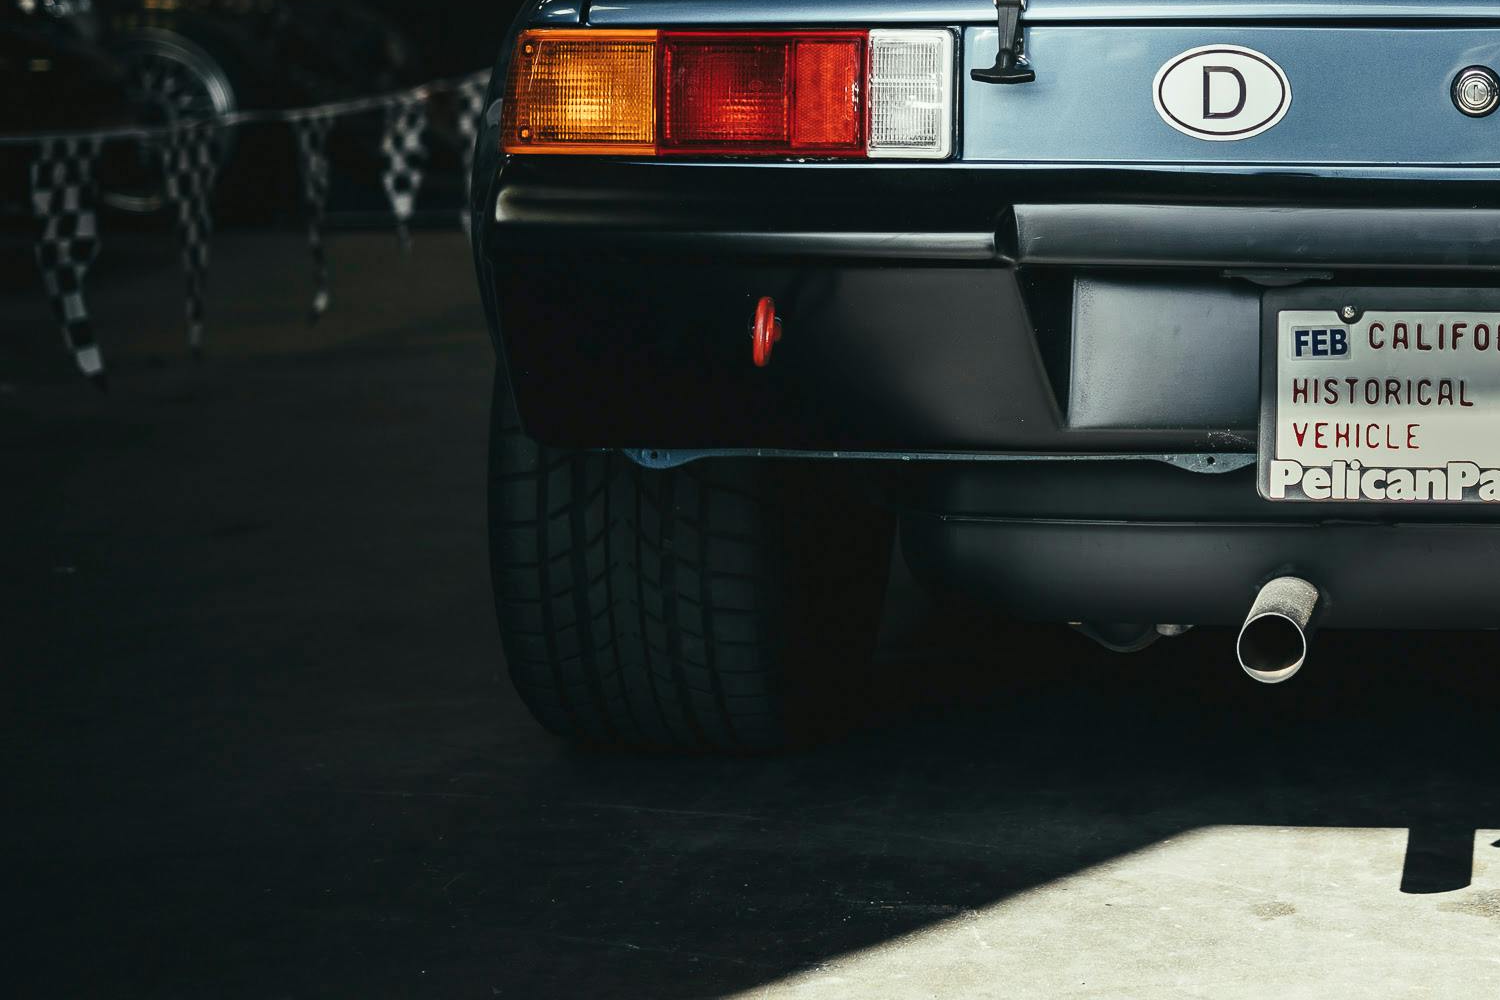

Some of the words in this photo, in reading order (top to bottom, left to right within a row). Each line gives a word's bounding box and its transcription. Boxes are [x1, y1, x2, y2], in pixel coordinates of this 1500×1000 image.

[1203, 66, 1246, 119] D
[1294, 328, 1348, 356] FEB
[1292, 378, 1474, 407] HISTORICAL
[1292, 422, 1421, 450] VEHICLE
